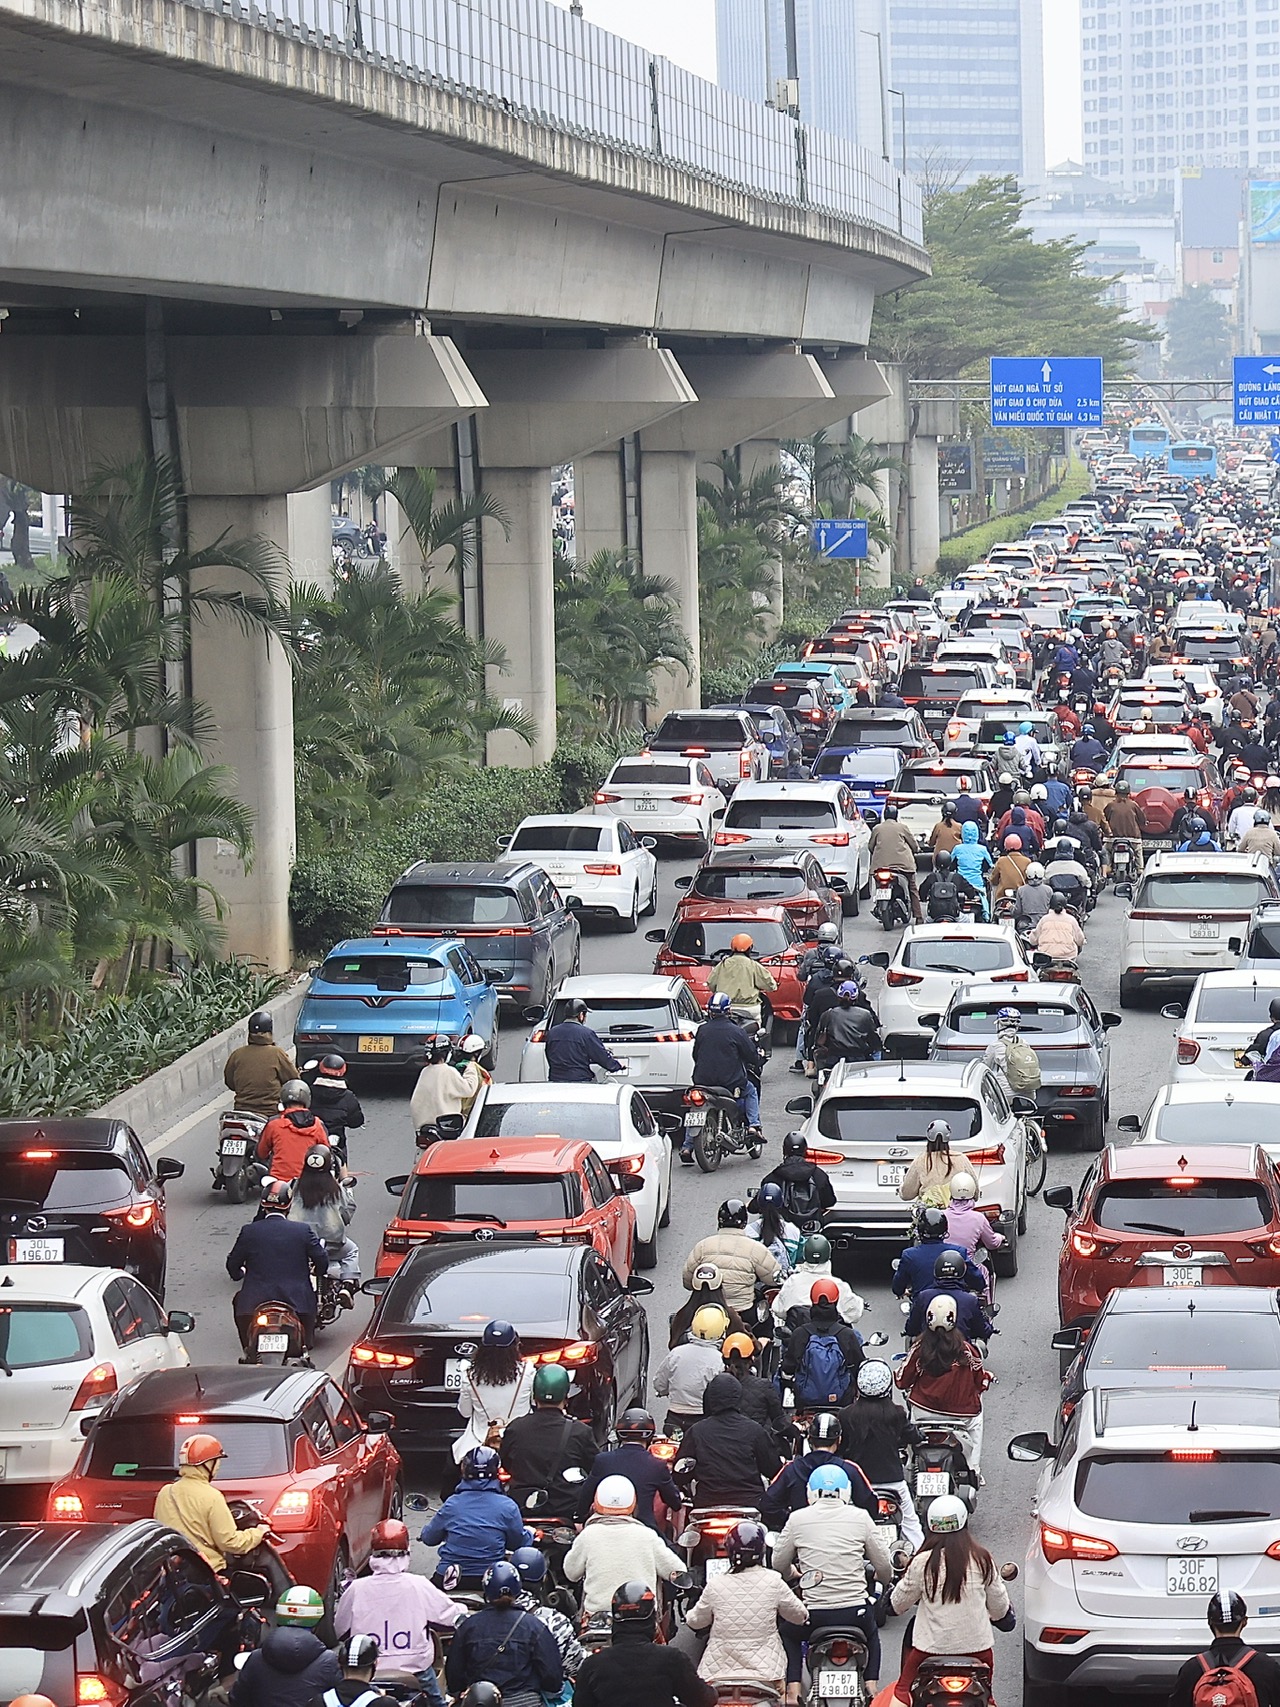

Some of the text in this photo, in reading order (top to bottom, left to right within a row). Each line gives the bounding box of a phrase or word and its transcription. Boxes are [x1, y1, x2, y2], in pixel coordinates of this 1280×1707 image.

[993, 382, 1063, 393] NÚT GIAO NGÃ TƯ SỞ
[1238, 381, 1261, 392] ĐƯỜNG
[993, 396, 1006, 407] NÚT
[1008, 398, 1024, 407] GIAO
[1032, 398, 1046, 408] CHỢ
[1049, 396, 1062, 407] DỪA
[1089, 398, 1100, 407] km
[1239, 395, 1252, 406] NÚT
[1253, 397, 1269, 406] GIAO
[1009, 409, 1024, 421] MIẾU
[1026, 409, 1044, 422] QUỐC
[1056, 410, 1073, 421] GIÁM
[1089, 412, 1100, 421] km
[361, 1044, 390, 1053] 361.60
[30, 1239, 50, 1250] 30L
[22, 1250, 59, 1261] 196.07
[1173, 1268, 1193, 1280] 30E
[1179, 1560, 1206, 1575] 30F
[1169, 1577, 1217, 1593] 346.82
